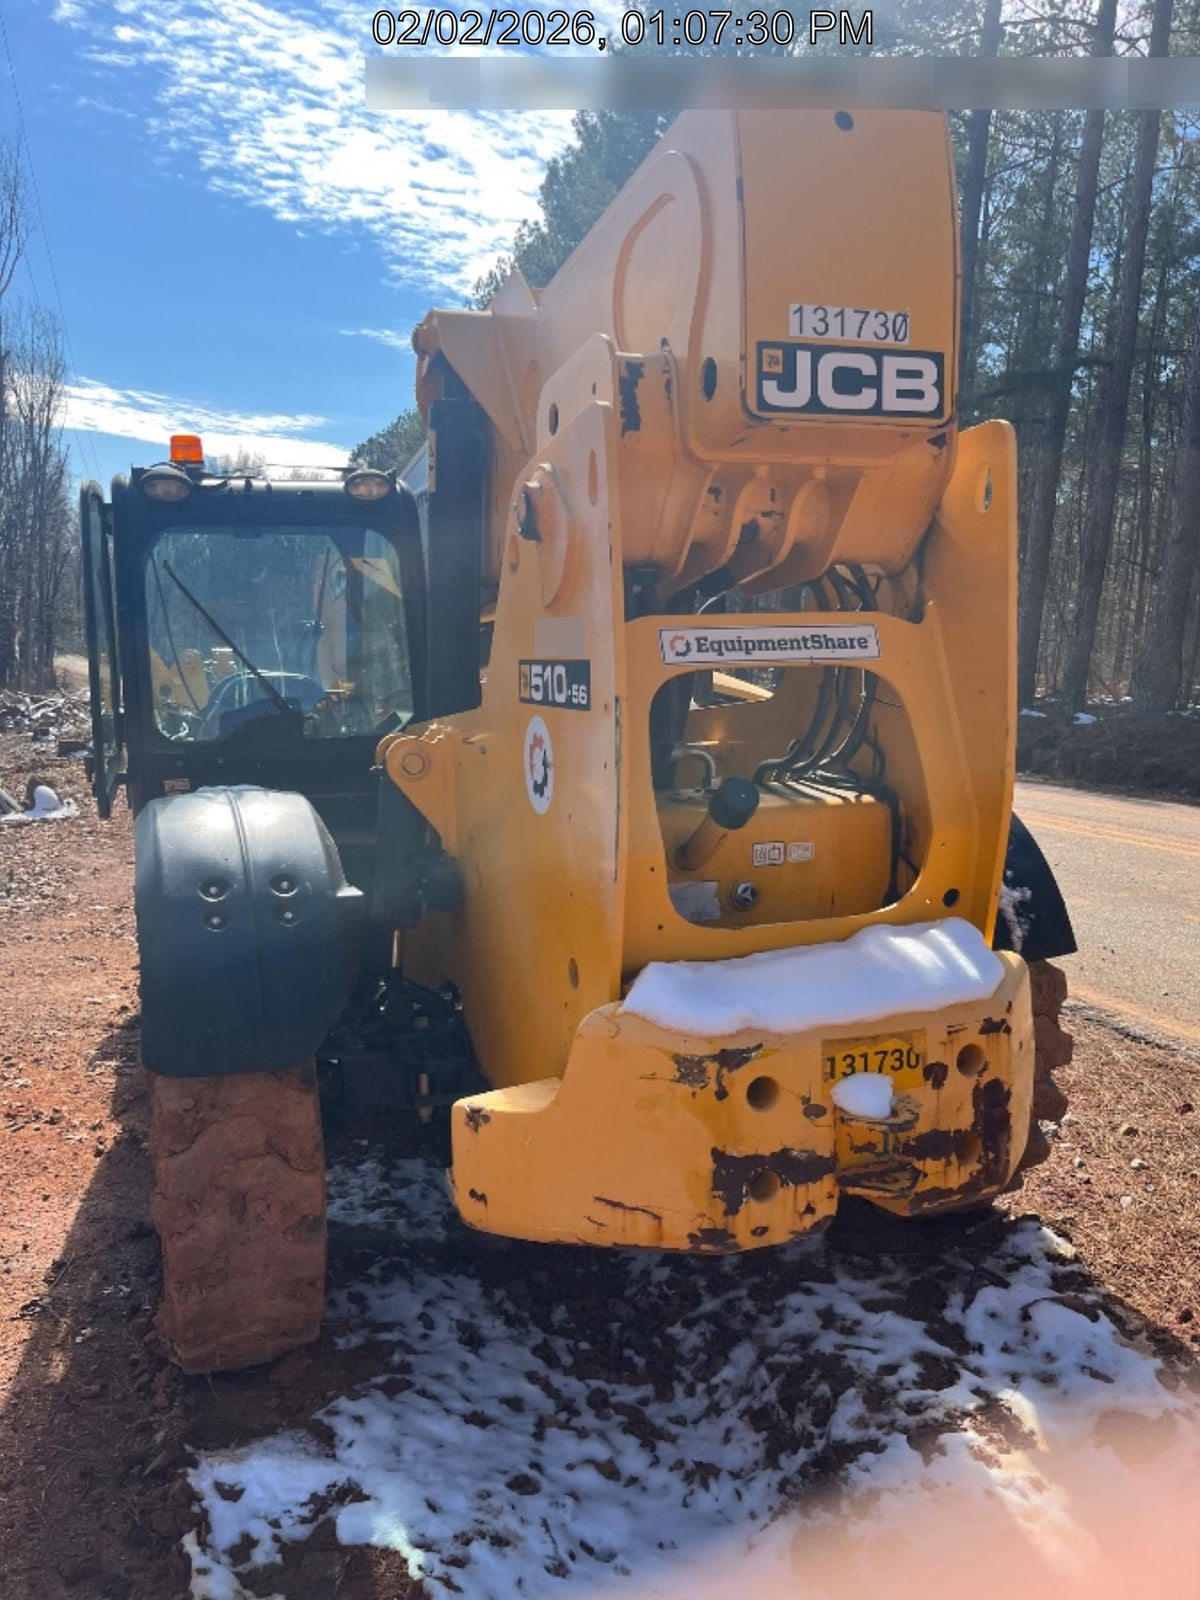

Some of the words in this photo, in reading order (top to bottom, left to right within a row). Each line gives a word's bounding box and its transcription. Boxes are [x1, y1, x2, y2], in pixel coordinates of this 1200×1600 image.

[793, 305, 909, 342] 131730
[762, 350, 939, 412] JCB
[695, 634, 868, 655] EquipmentShare
[827, 1045, 920, 1079] 131730
